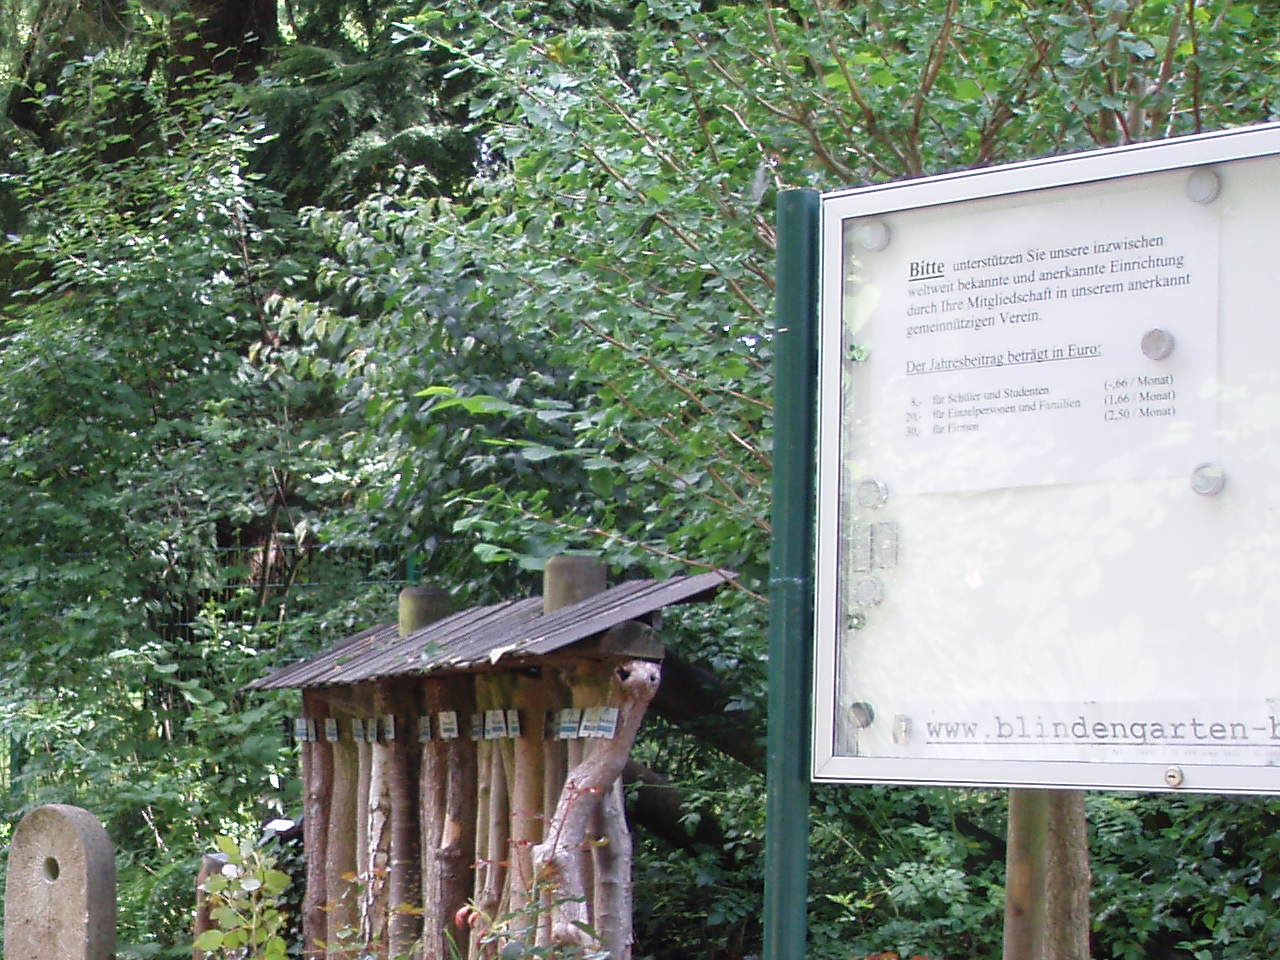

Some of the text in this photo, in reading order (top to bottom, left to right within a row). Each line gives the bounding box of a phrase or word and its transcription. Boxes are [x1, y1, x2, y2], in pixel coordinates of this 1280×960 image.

[908, 235, 1164, 280] Bitte unterstützen Sie unsere inzwischen
[908, 255, 1185, 297] weltweit bekannte und anerkannte Einrichtung
[907, 273, 1191, 317] durch Ihre Mitgliedschaft in unserem anerkannt
[906, 311, 1041, 339] gemeinnützigen Verein.
[906, 343, 1102, 374] Der Jahresbeitrag beträgt in Euro:
